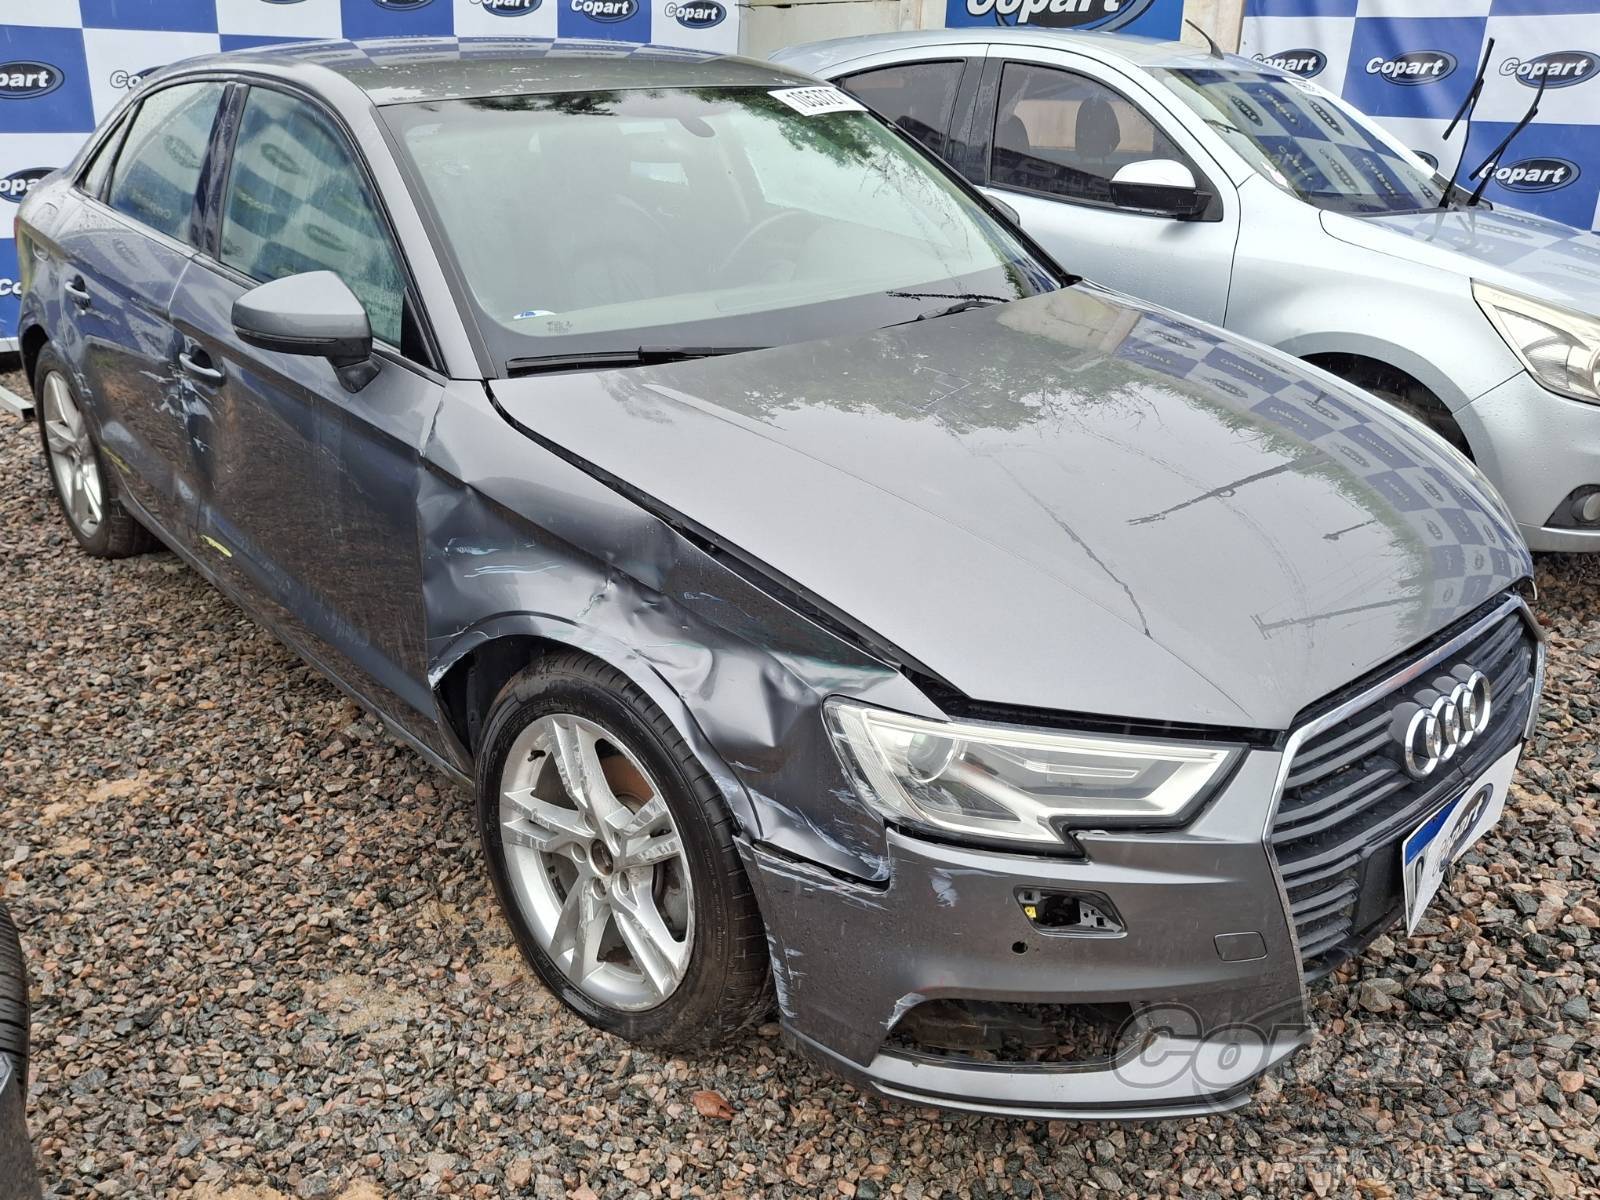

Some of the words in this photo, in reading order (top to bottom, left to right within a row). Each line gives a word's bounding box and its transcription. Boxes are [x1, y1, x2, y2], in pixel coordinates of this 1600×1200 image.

[570, 0, 629, 15] Copart
[665, 2, 718, 20] Copart
[1366, 57, 1444, 78] Copart
[1499, 57, 1588, 79] Copart
